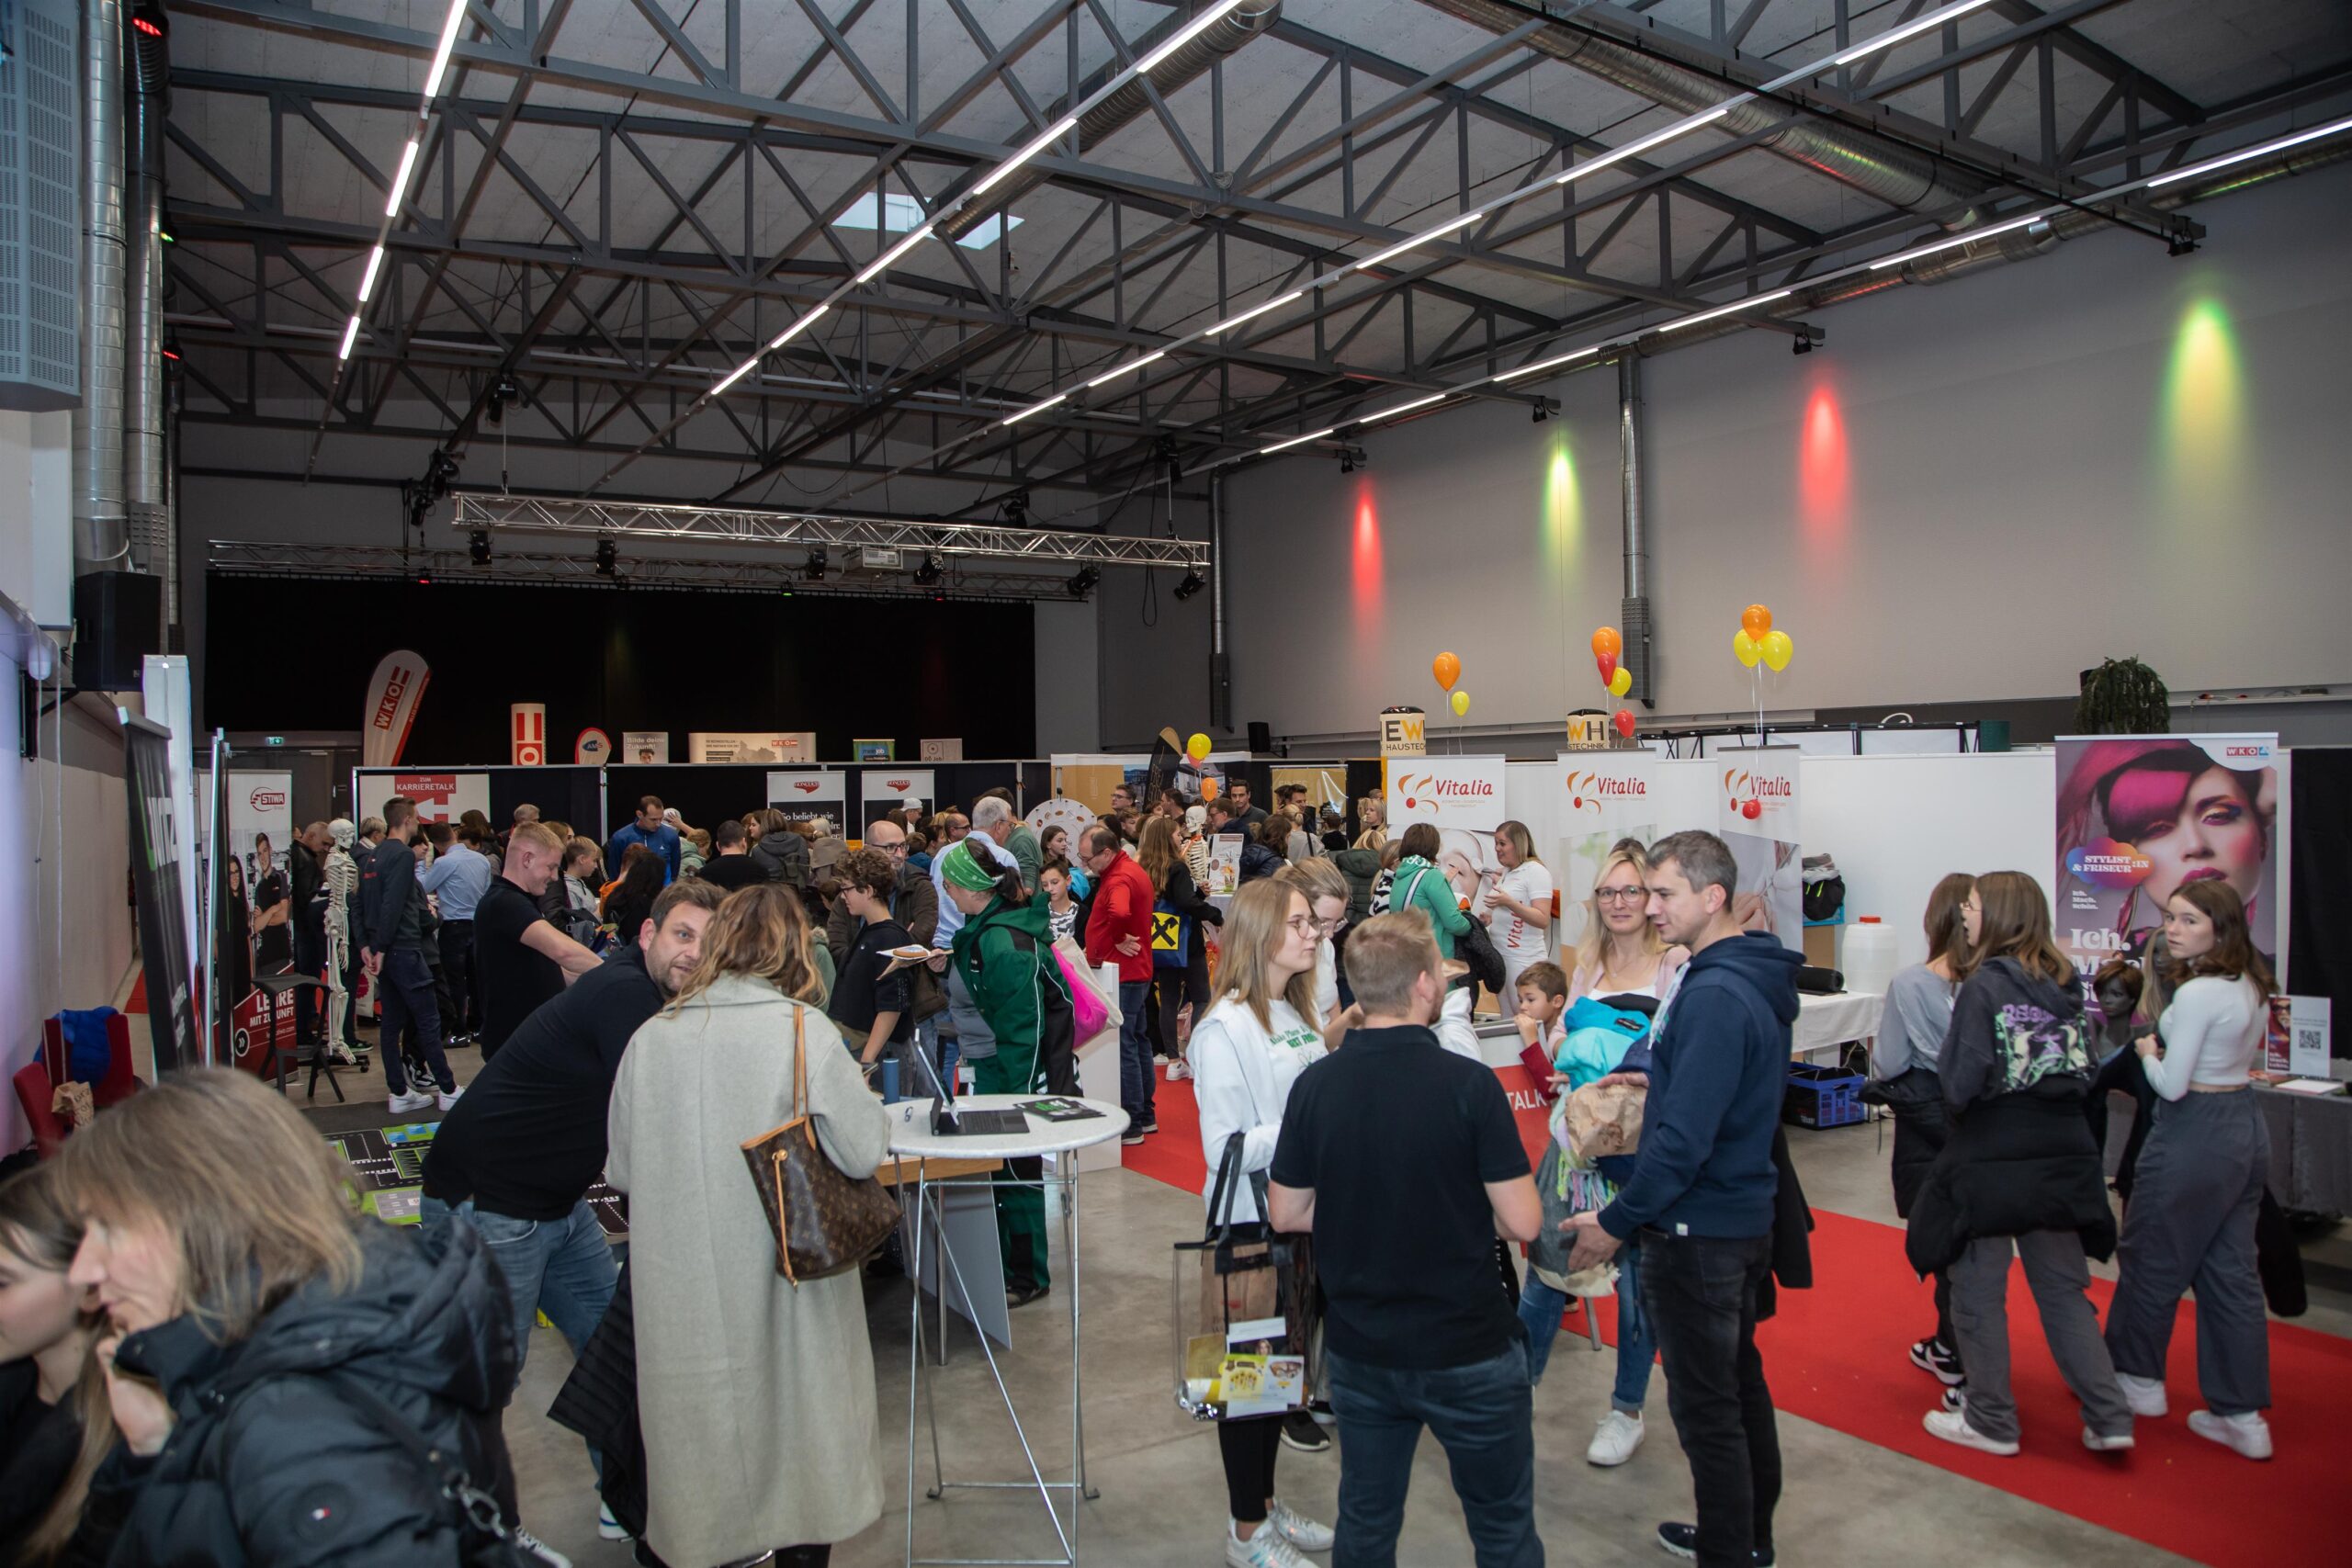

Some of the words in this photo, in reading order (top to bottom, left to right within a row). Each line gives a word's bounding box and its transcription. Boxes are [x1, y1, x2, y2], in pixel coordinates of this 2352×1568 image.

[376, 684, 401, 727] WKO
[1385, 720, 1426, 742] EW
[2226, 747, 2258, 756] WKO
[1435, 779, 1494, 796] Vitalia
[1598, 777, 1646, 795] Vitalia
[1750, 775, 1792, 796] Vitalia
[262, 795, 284, 804] STIWA
[792, 811, 819, 821] beliebt
[2072, 863, 2082, 872] &
[2083, 863, 2132, 873] FRISEUR
[2084, 855, 2132, 864] STYLIST
[1507, 900, 1523, 948] Vital
[2070, 927, 2132, 952] Ich.
[249, 1015, 262, 1027] MIT
[263, 1006, 294, 1023] ZUUNFT
